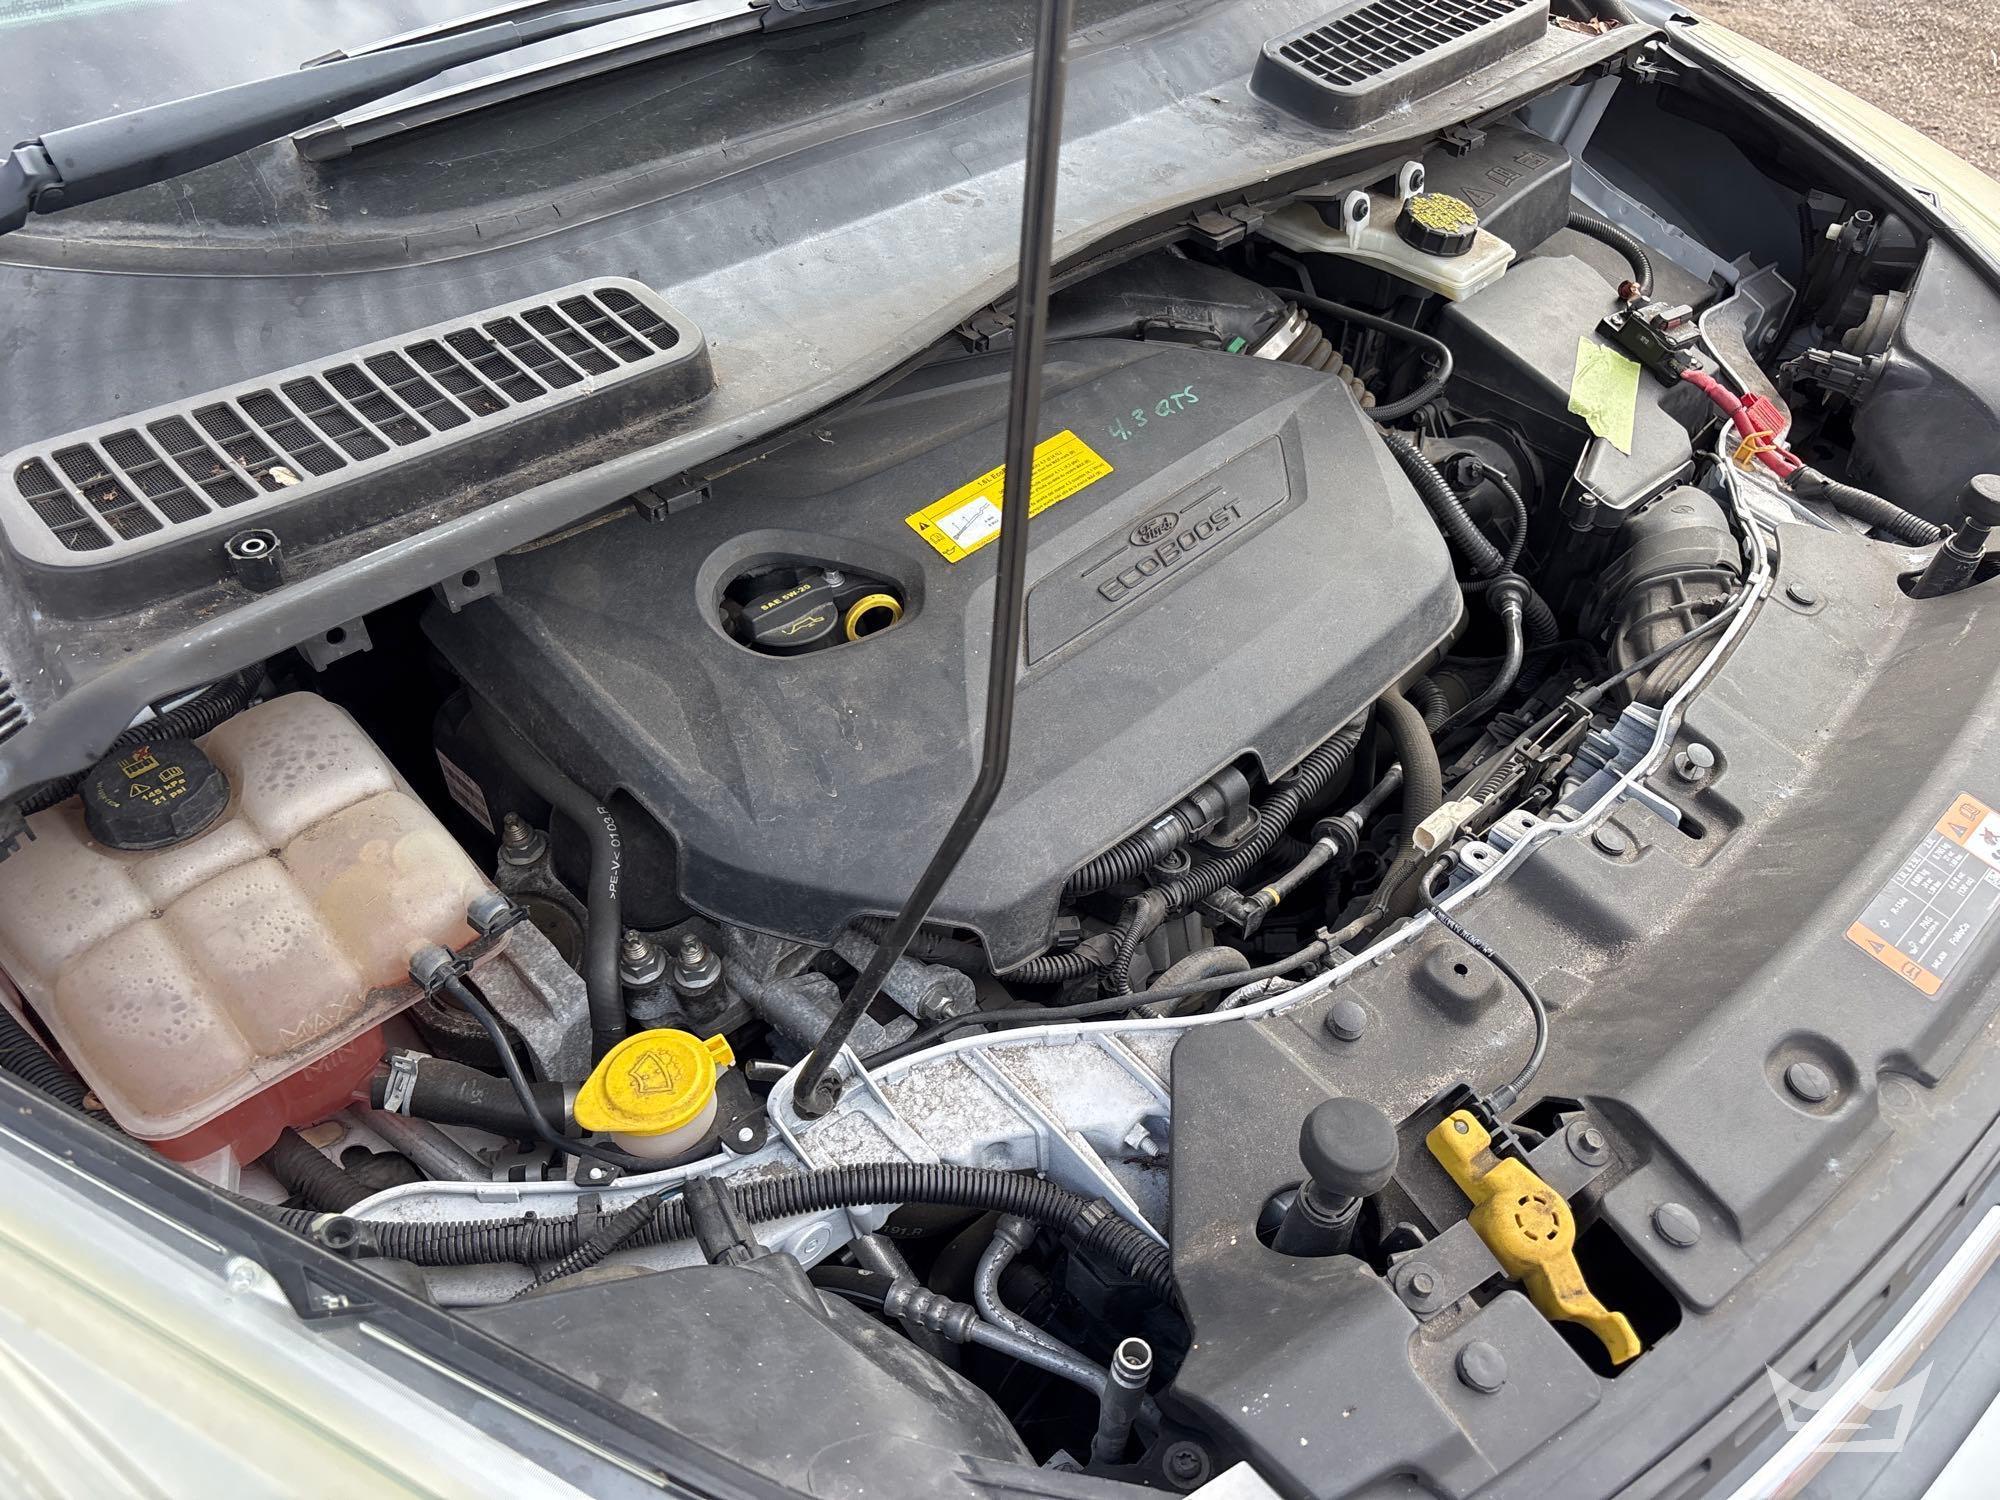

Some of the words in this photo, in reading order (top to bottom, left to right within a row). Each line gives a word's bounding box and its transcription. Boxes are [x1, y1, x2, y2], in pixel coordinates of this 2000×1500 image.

[1154, 385, 1200, 417] QTS
[1137, 516, 1174, 544] Ford
[1098, 498, 1242, 602] ECOBOOST
[760, 598, 783, 610] SAE
[781, 584, 811, 600] 5W-20
[141, 788, 163, 801] 145
[152, 795, 167, 806] 21
[1919, 915, 1934, 930] PAG
[1948, 922, 1970, 946] FoMoCo
[279, 992, 355, 1049] MAX
